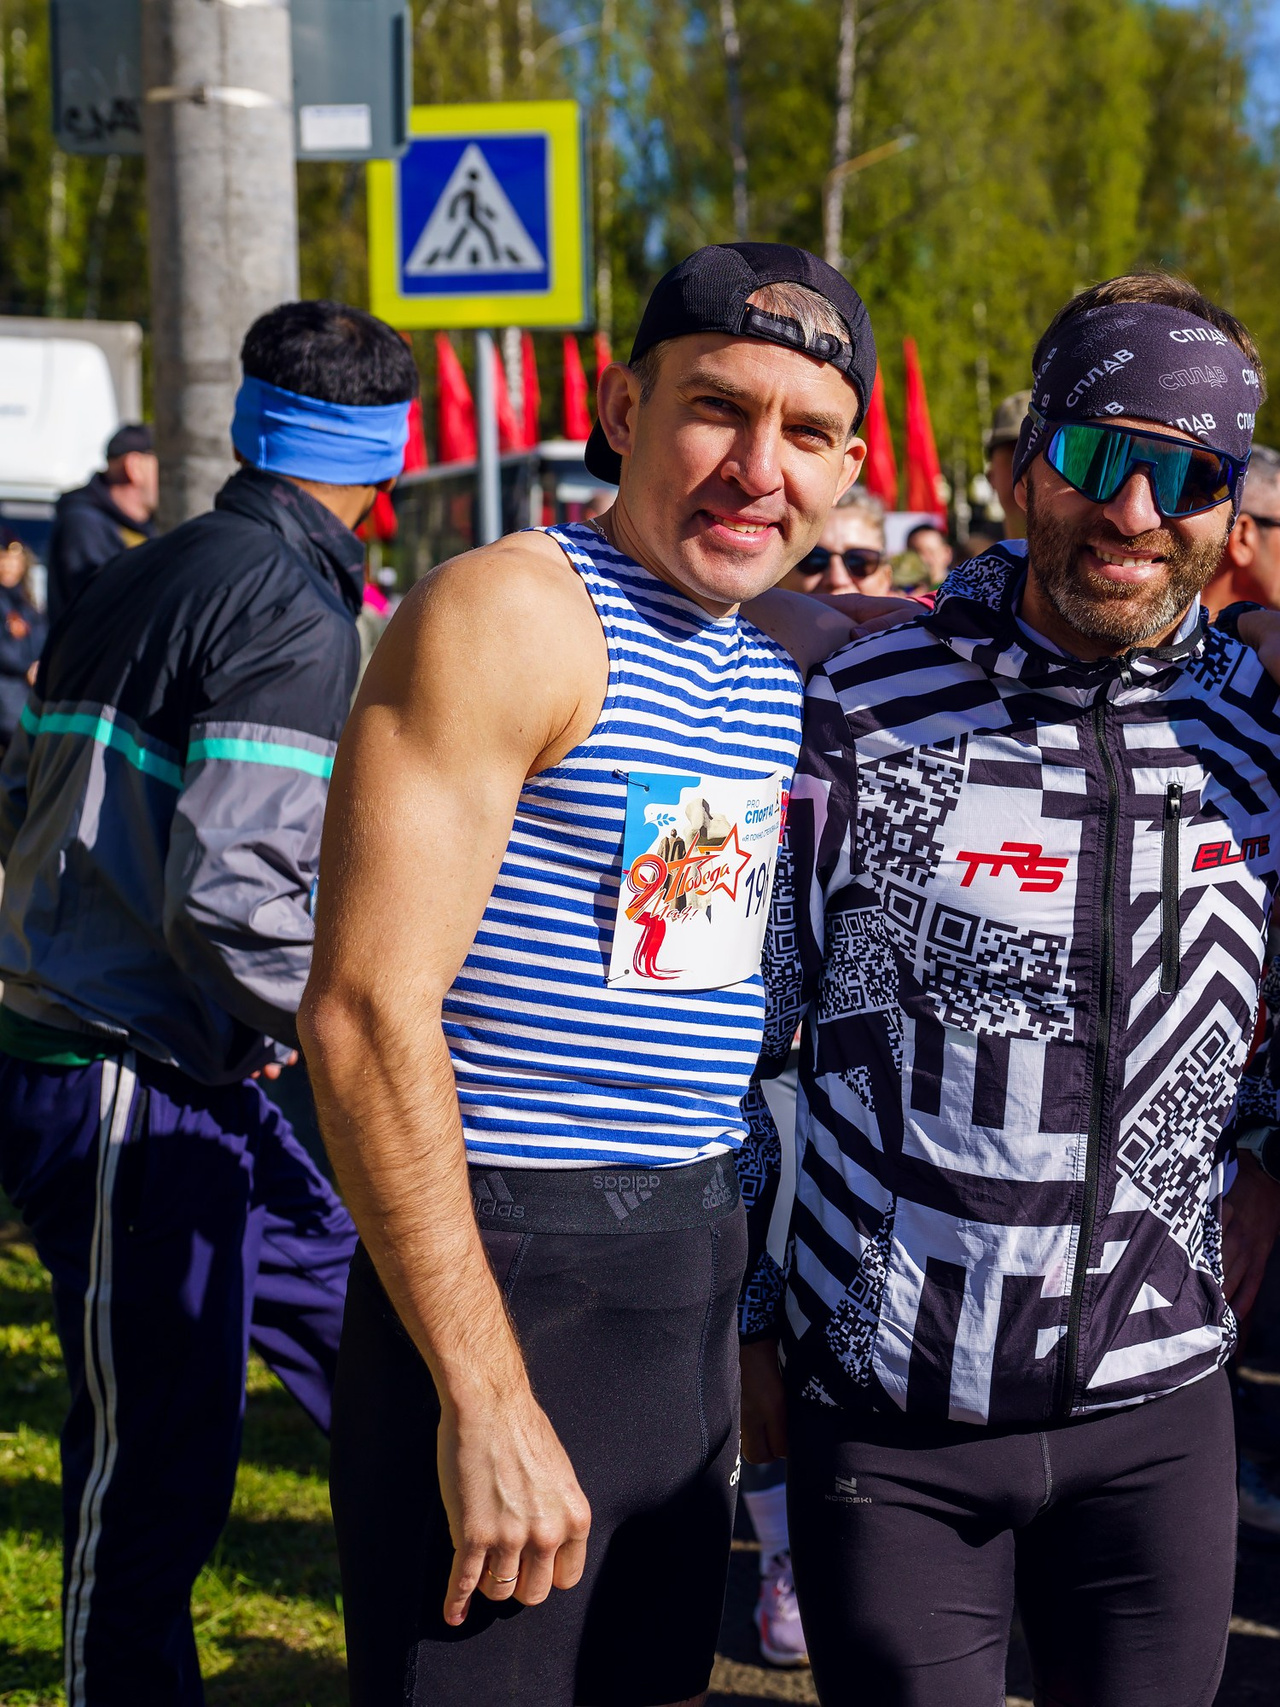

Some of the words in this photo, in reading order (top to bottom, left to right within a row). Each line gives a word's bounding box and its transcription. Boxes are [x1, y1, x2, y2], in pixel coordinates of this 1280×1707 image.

[1169, 327, 1229, 346] СПЛАВ
[1066, 349, 1135, 408] СПЛАВ
[1159, 365, 1229, 390] СПЛАВ
[1191, 835, 1270, 872] ELITE
[955, 841, 1070, 893] TRS
[593, 1175, 660, 1190] adidas
[702, 1187, 733, 1211] adidas
[825, 1494, 872, 1504] NORDSKI
